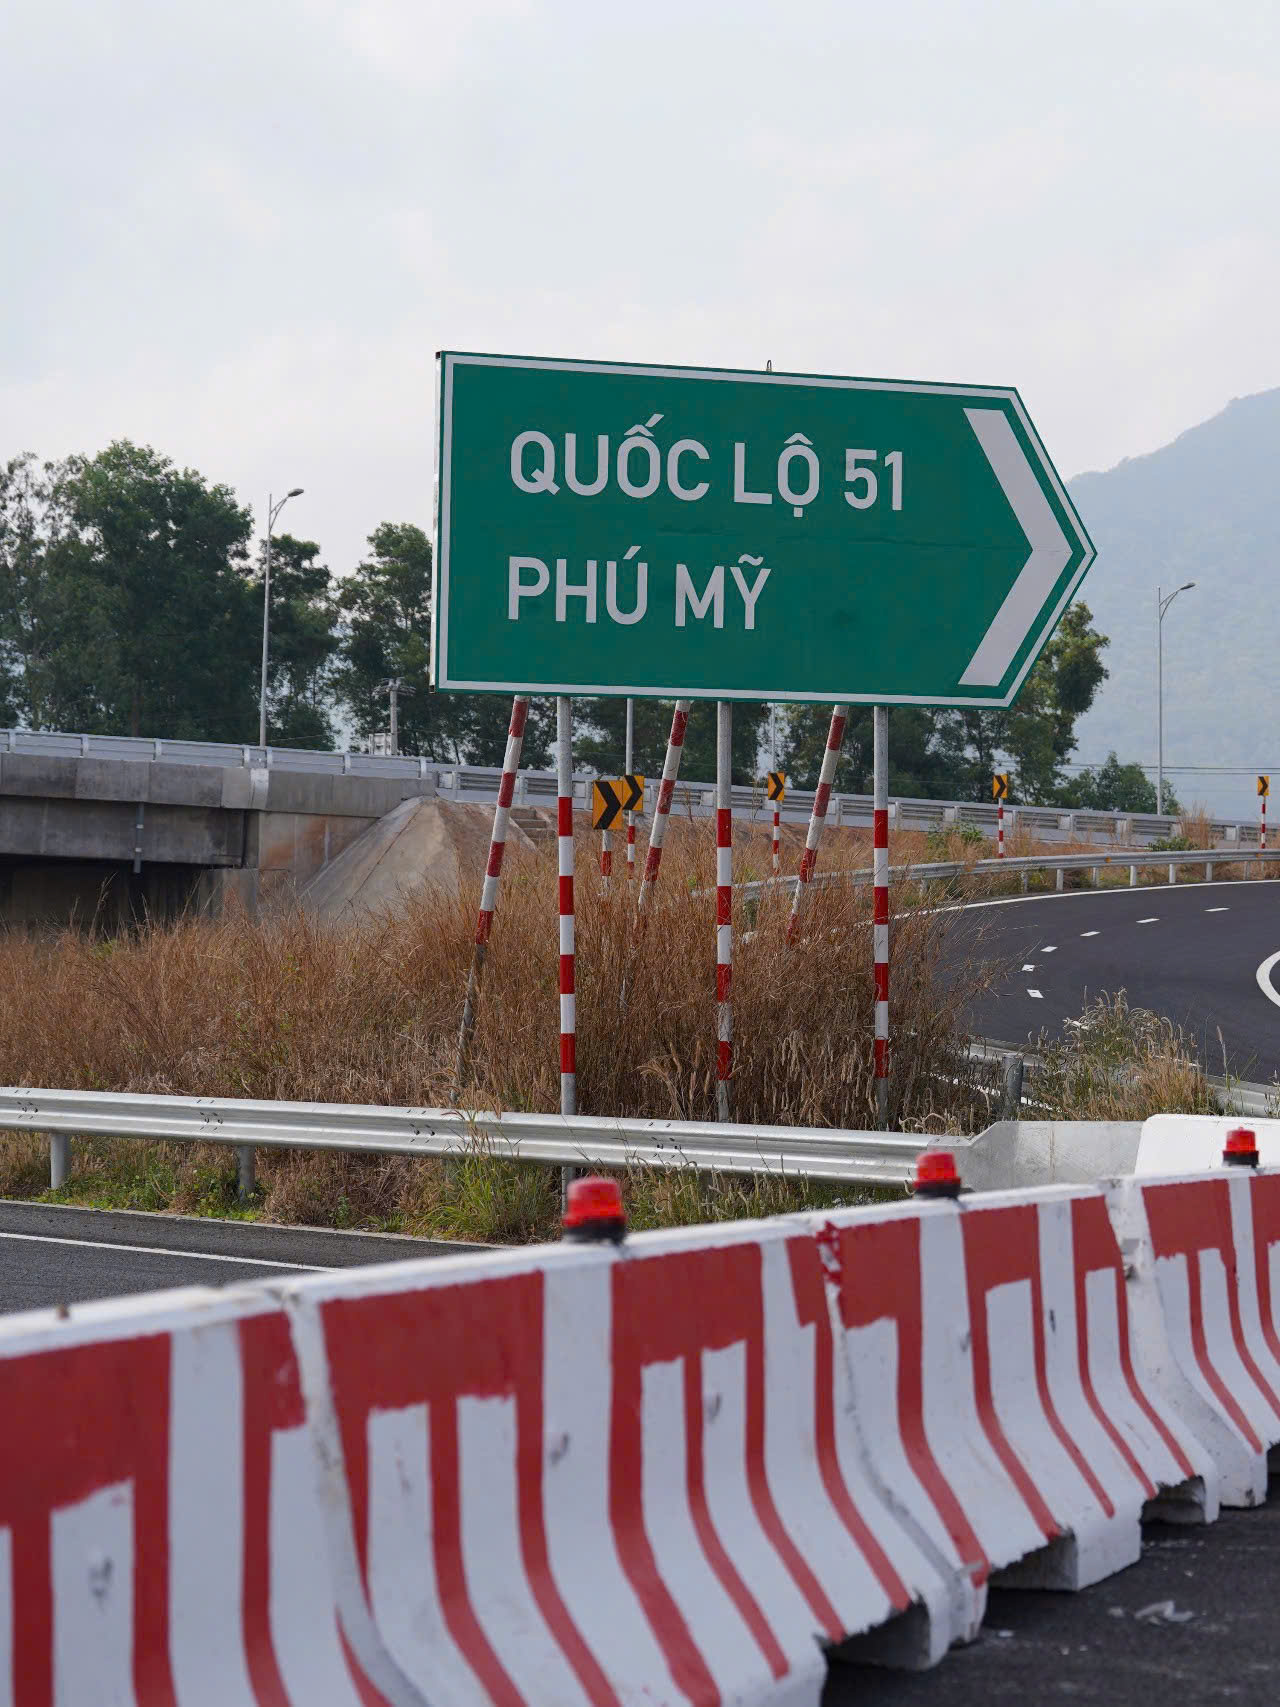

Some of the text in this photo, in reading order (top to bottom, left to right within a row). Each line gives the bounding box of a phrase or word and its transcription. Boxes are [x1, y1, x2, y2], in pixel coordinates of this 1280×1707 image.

[511, 414, 903, 517] QUỐC LỘ 51
[508, 546, 772, 630] PHÚ MỸ
